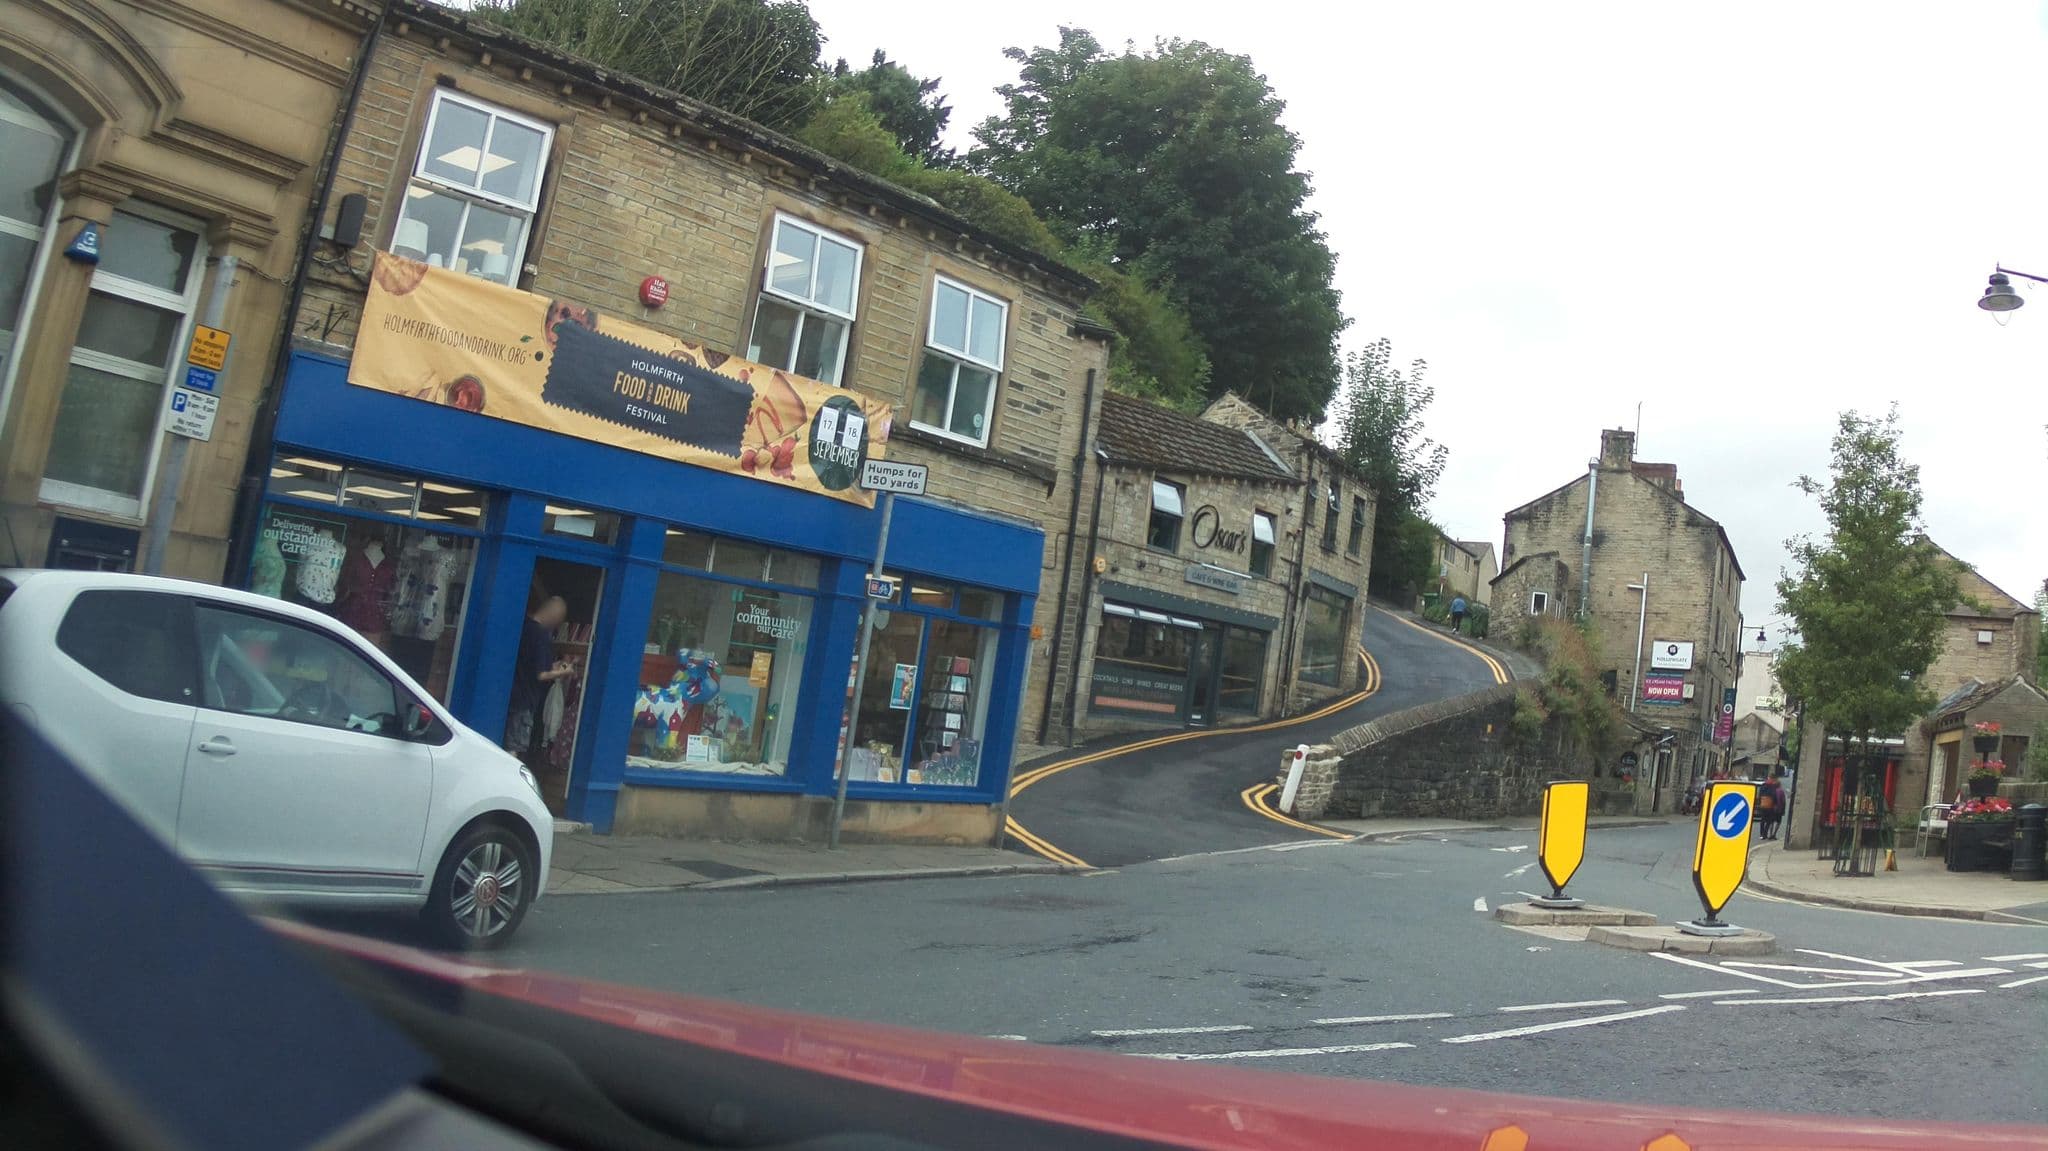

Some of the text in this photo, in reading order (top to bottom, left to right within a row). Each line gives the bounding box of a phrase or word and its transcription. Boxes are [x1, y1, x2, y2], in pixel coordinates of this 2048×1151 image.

[384, 313, 527, 365] HOLMFIRTHFOODANDDRINK.ORG
[631, 360, 684, 385] HOLMFIRTH
[613, 371, 646, 400] FOOD
[654, 384, 691, 415] DRINK
[174, 394, 185, 410] P
[626, 404, 667, 424] FESTIVAL
[868, 464, 922, 479] Humps for
[868, 475, 919, 490] 150 yards
[272, 518, 314, 534] Delivering
[1192, 504, 1247, 555] Oscar's
[264, 529, 335, 549] outstanding
[281, 542, 307, 554] care
[750, 604, 770, 616] Your
[737, 613, 801, 633] community
[757, 625, 794, 639] our care
[1648, 687, 1663, 695] NOW
[1663, 688, 1679, 696] OPEN
